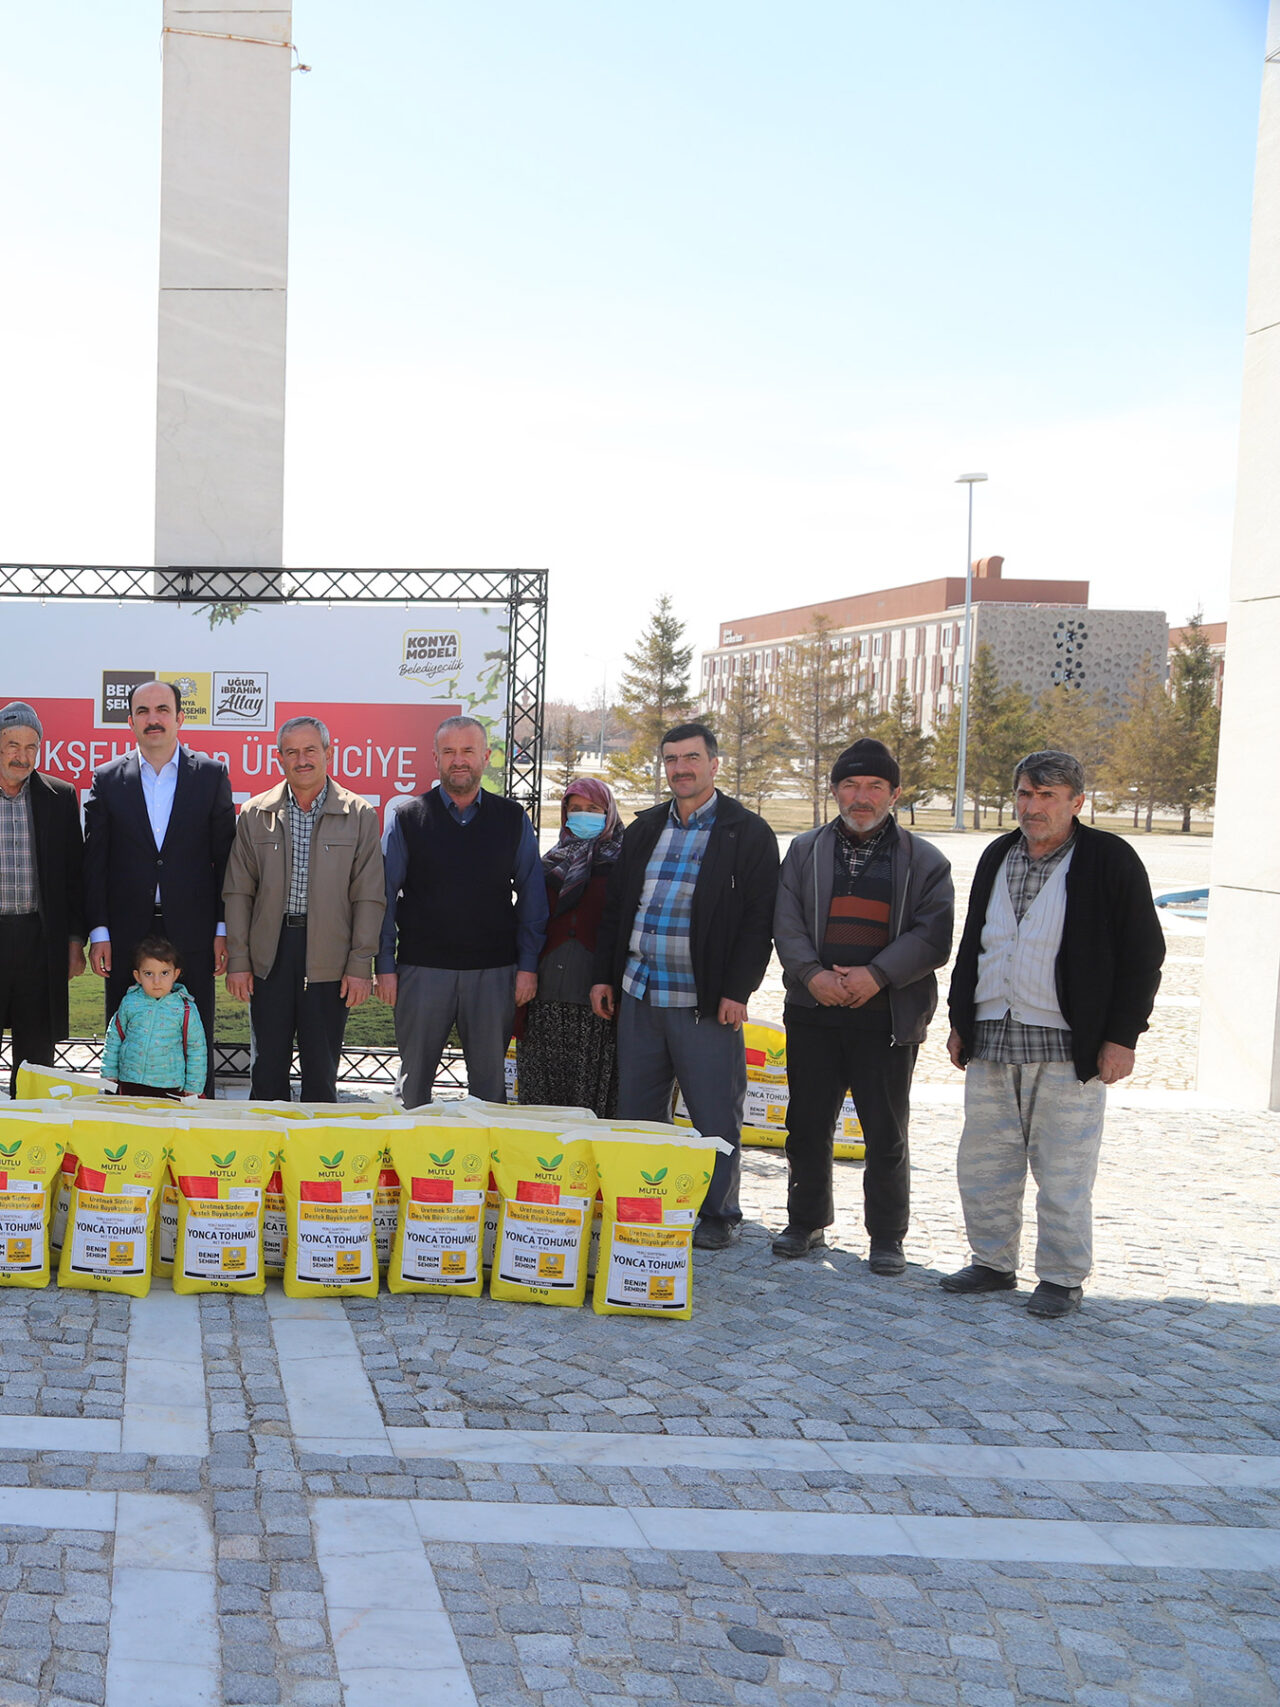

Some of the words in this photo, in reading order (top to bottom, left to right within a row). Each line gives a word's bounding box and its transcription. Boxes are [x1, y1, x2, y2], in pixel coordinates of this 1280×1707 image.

[408, 635, 457, 648] KONYA
[399, 658, 464, 679] Belediyecilik
[227, 677, 254, 687] UĞUR
[106, 684, 135, 697] BEN
[106, 698, 130, 711] ŞEH
[217, 694, 264, 717] Altay
[242, 735, 417, 778] ÜRİCİYE
[747, 1091, 764, 1100] ONCA
[766, 1093, 790, 1101] TOHUM
[535, 1173, 562, 1181] MUTLU
[5, 1222, 41, 1232] TOHUMU
[77, 1222, 105, 1234] YONCA
[108, 1225, 144, 1234] TOHUMU
[188, 1229, 217, 1240] YONCA
[219, 1231, 256, 1240] TOHUMU
[301, 1234, 331, 1244] YONCA
[407, 1232, 437, 1244] YONCA
[440, 1235, 476, 1244] TOHUMU
[506, 1231, 535, 1244] YONCA
[538, 1237, 577, 1247] TOHUMU
[613, 1254, 645, 1267] YONCA
[649, 1259, 686, 1269] TOHUMU
